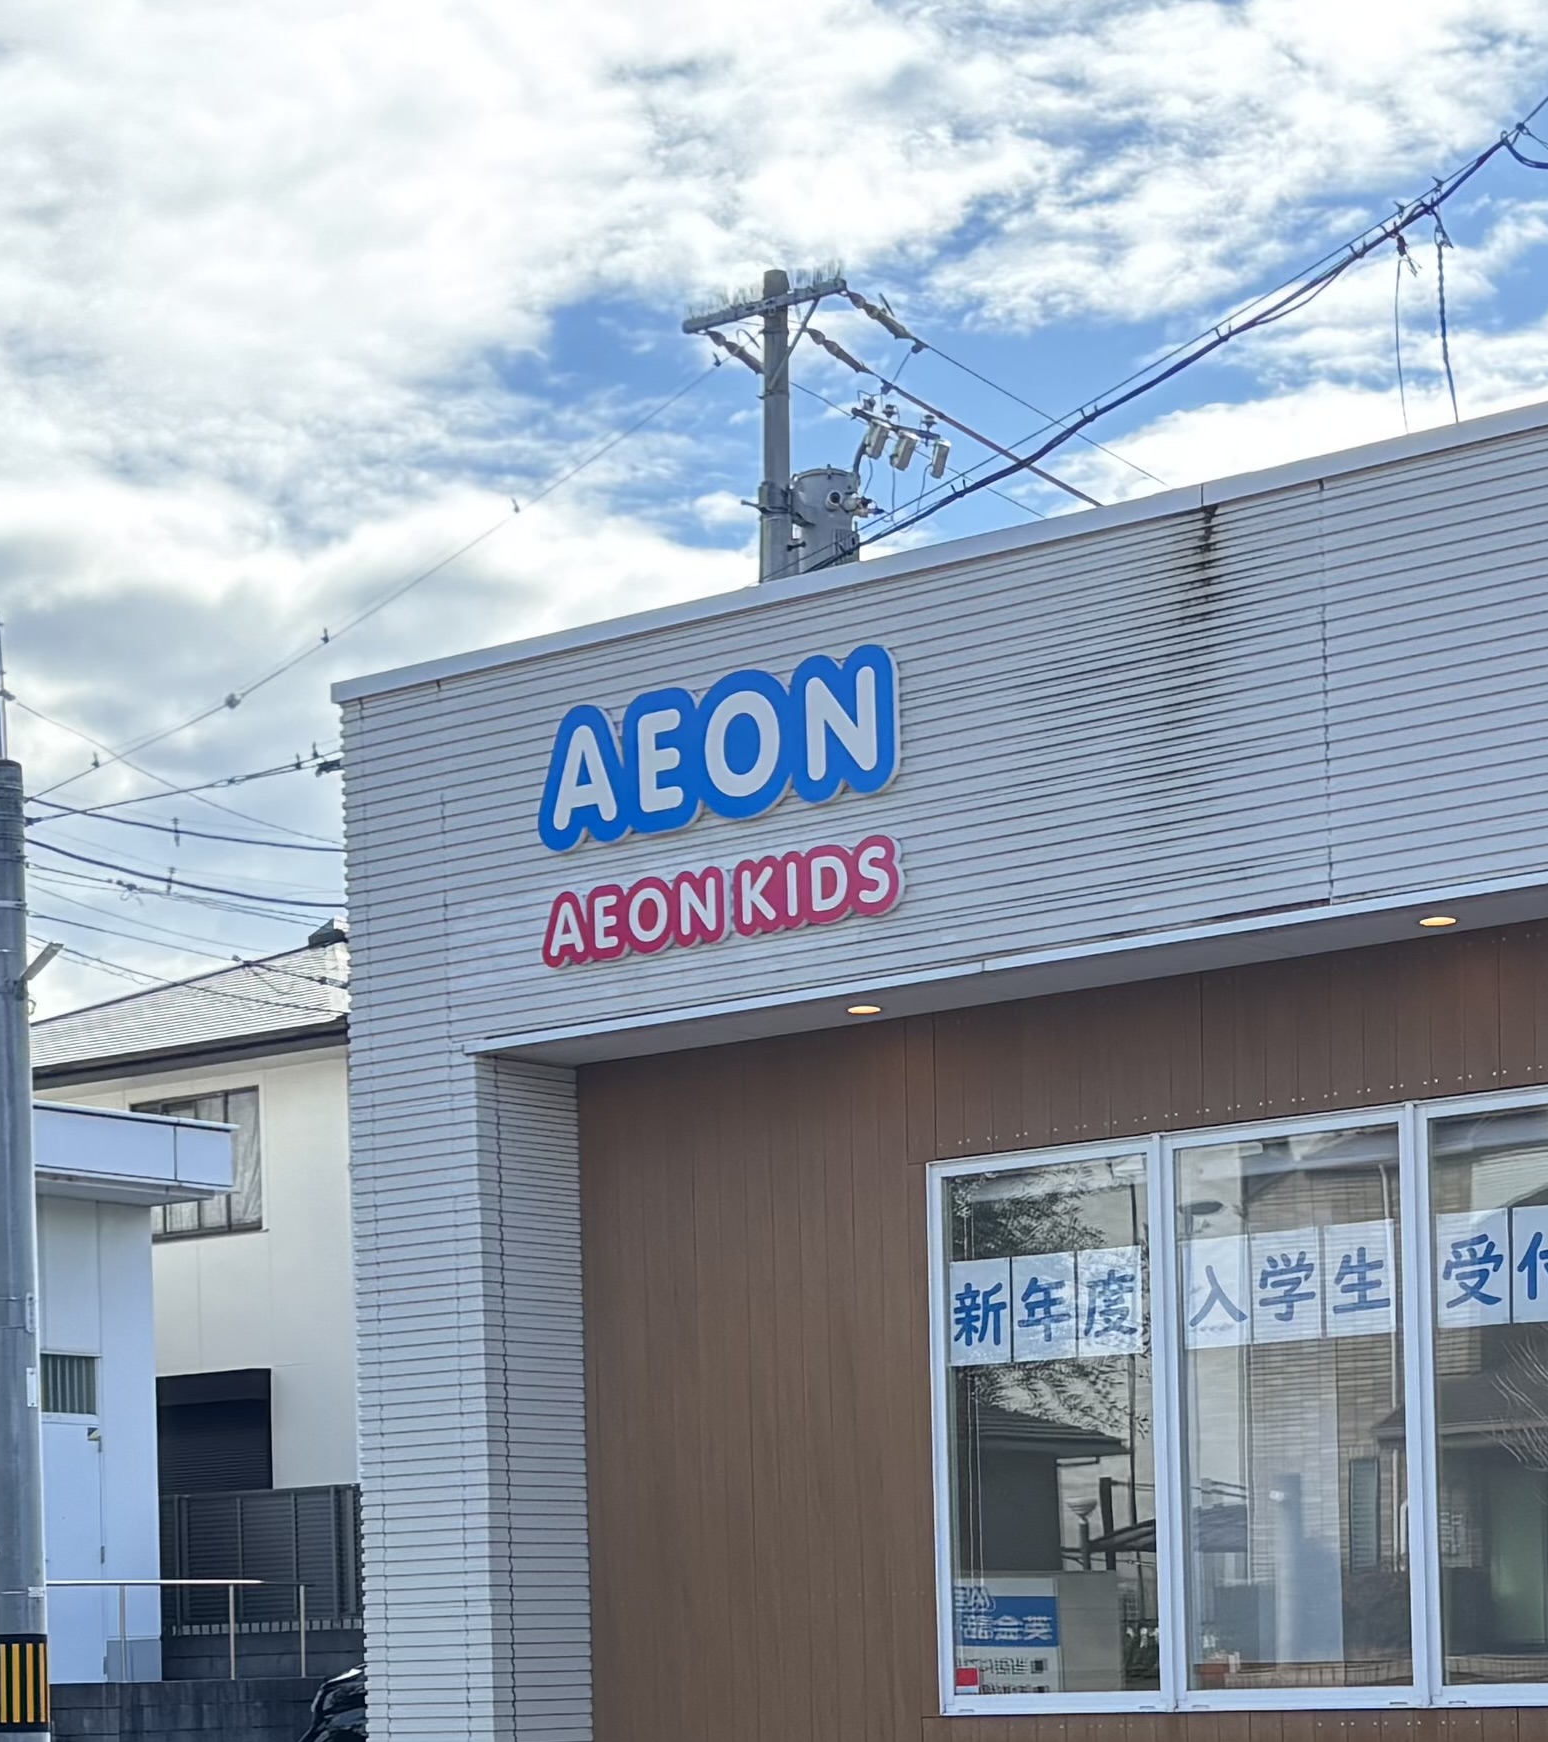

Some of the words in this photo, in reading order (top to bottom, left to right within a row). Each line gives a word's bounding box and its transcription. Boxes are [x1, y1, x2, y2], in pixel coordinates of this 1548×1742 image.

[538, 644, 900, 852] AEON
[542, 866, 727, 969] AEON
[733, 834, 903, 938] KIDS
[953, 1269, 1138, 1347] 新年度
[1190, 1246, 1391, 1327] 入学生
